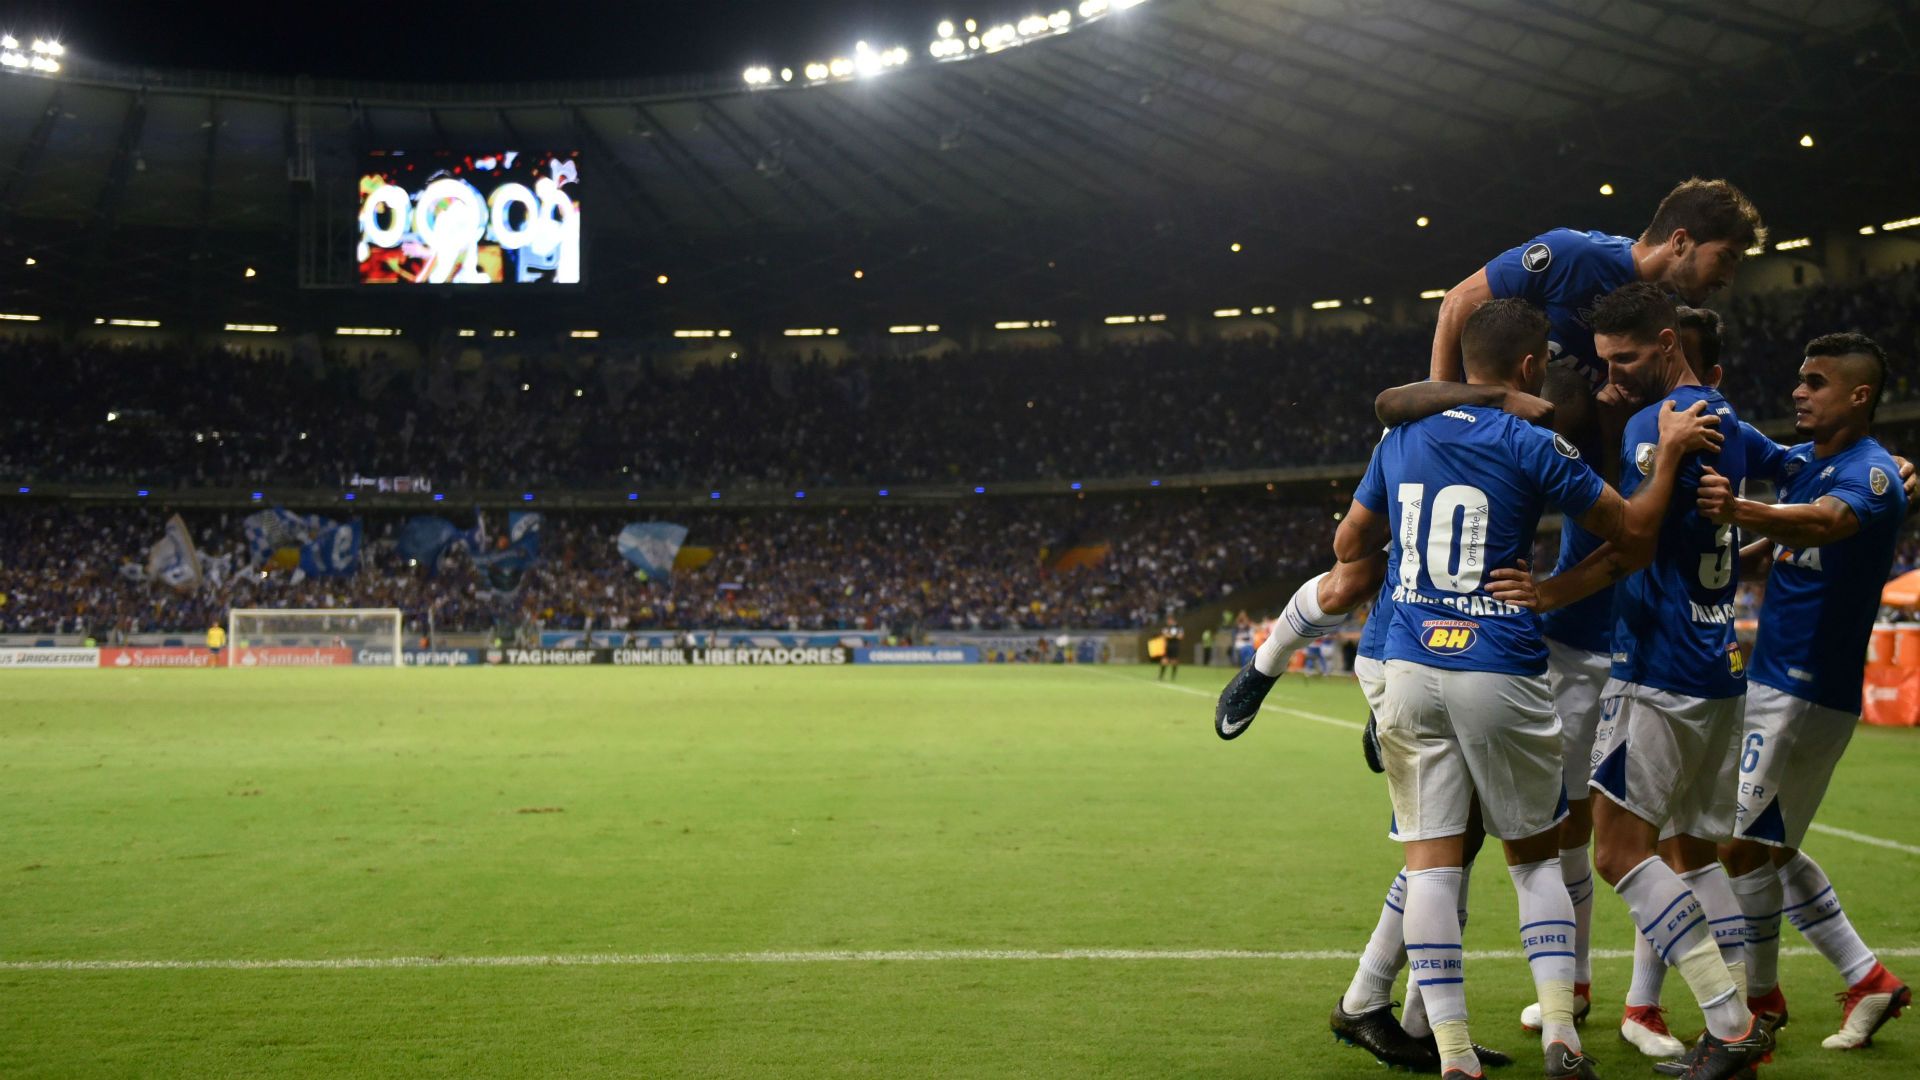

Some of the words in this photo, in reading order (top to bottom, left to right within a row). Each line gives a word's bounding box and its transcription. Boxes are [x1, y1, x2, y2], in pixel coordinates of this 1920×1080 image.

[1398, 483, 1488, 593] 10
[1466, 515, 1480, 567] Orthopride
[1428, 629, 1471, 648] BH
[16, 652, 97, 664] BRIDGESTONE
[134, 651, 209, 666] Santander
[258, 651, 336, 665] Santander
[416, 651, 469, 667] grande
[613, 649, 686, 665] CONMEBOL
[692, 649, 845, 665] LIBERTADORES
[1740, 733, 1764, 773] 6
